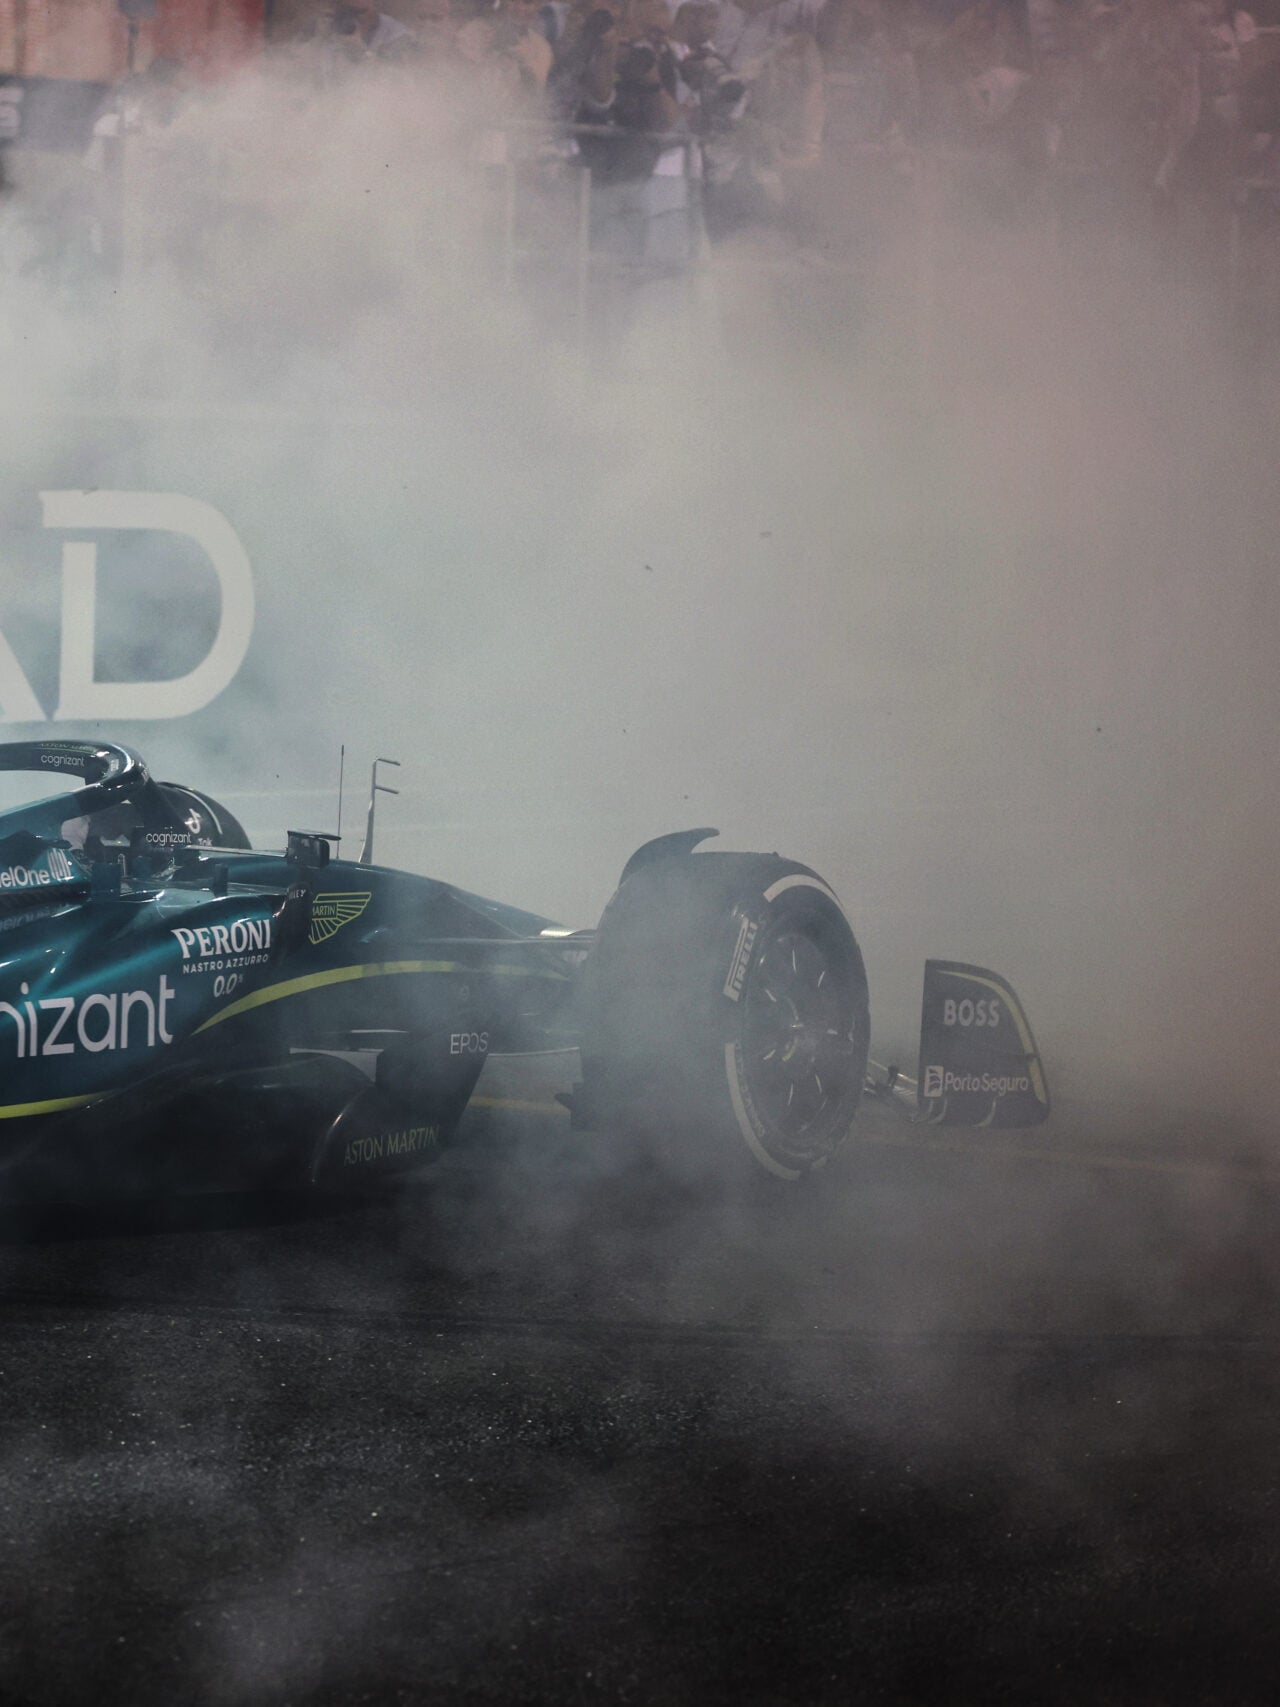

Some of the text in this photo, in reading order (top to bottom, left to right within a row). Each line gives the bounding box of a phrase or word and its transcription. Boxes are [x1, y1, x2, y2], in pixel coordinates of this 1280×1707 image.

[40, 753, 85, 767] cognizant
[145, 831, 192, 846] cognizant
[171, 919, 271, 959] PERONI
[182, 953, 269, 974] NASTRO AZZURRO
[723, 915, 759, 1002] PIRELLI
[943, 999, 1001, 1028] BOSS
[450, 1031, 489, 1055] EPOS
[344, 1125, 440, 1166] ASTON MARTIN
